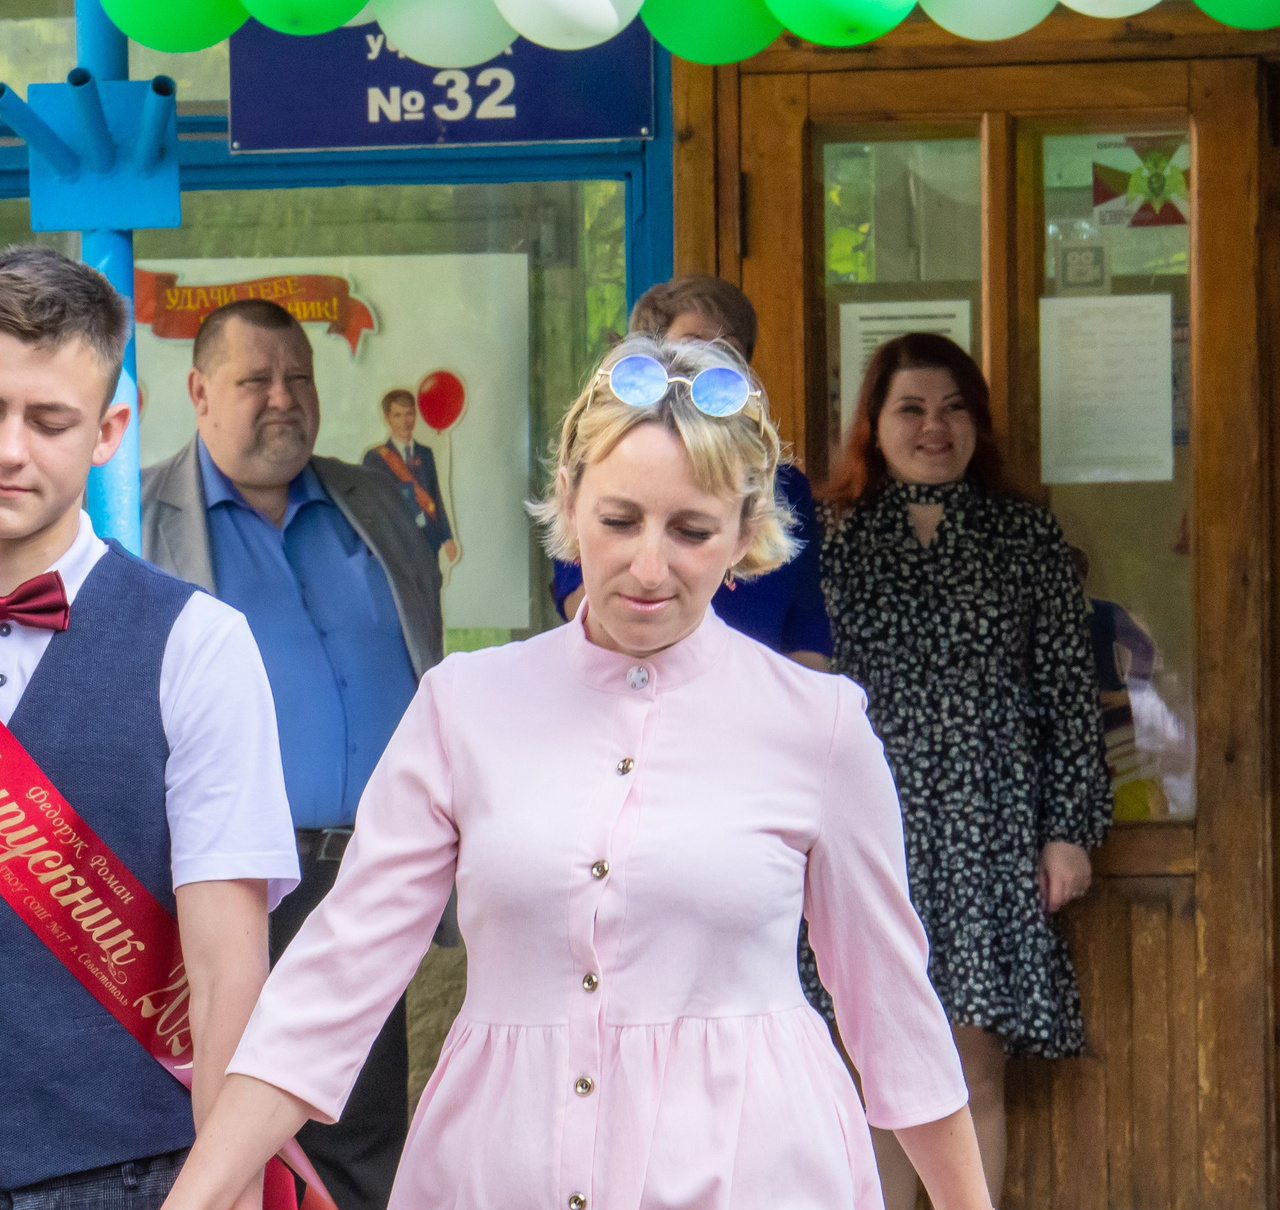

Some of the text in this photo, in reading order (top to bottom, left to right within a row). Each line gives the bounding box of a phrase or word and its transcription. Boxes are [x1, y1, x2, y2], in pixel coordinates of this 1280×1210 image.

[165, 286, 237, 310] УДАЧИ
[25, 786, 134, 904] Федорук Роман
[23, 895, 52, 921] СОШ
[47, 921, 72, 943] №17
[78, 952, 129, 1007] Севастополь
